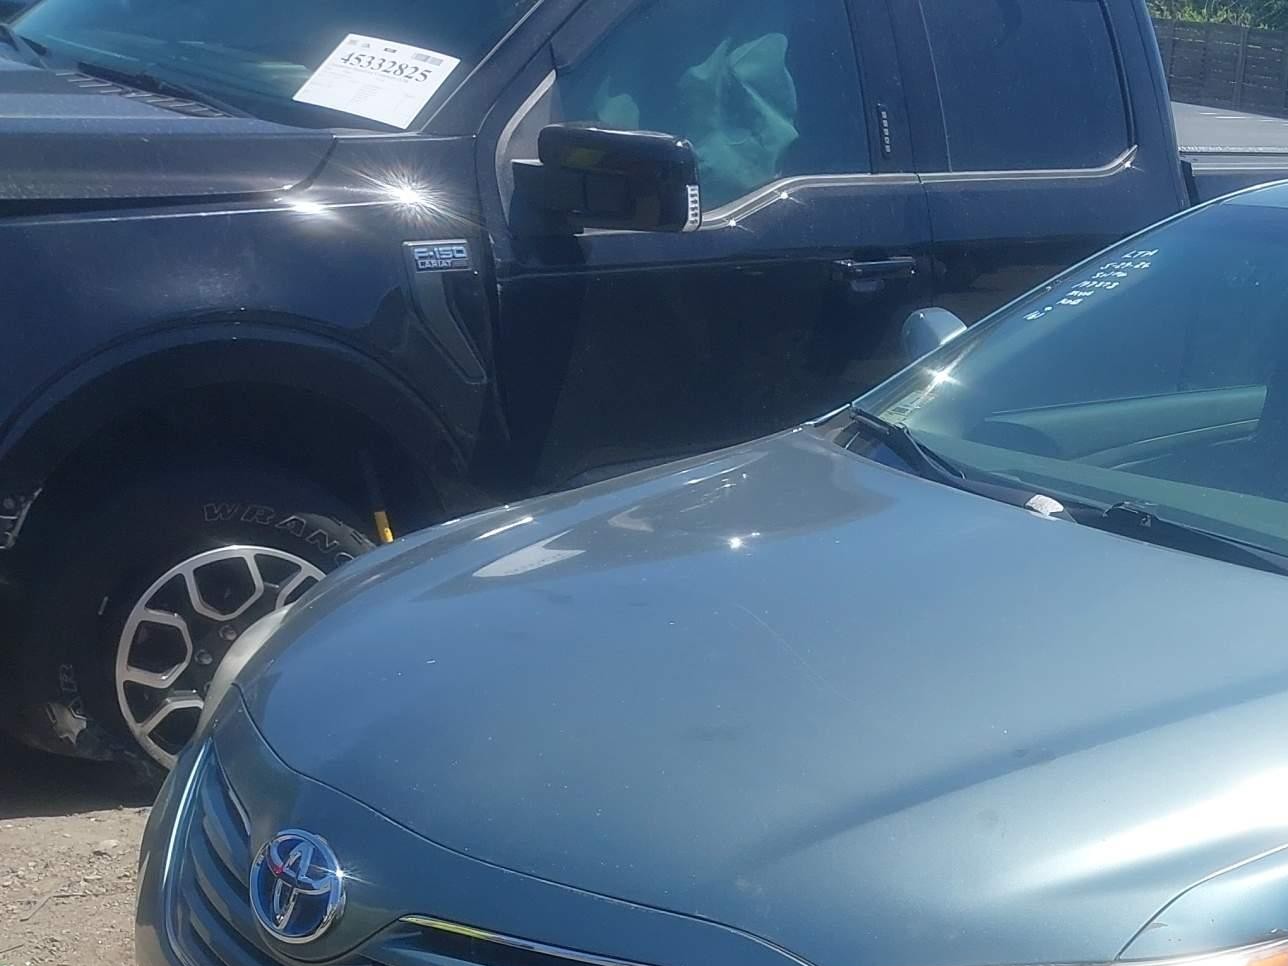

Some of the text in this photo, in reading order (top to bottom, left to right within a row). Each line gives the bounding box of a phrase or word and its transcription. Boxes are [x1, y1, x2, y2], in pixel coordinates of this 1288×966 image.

[340, 51, 433, 83] 45332825
[414, 247, 467, 260] F-150
[417, 260, 452, 269] LARIAT
